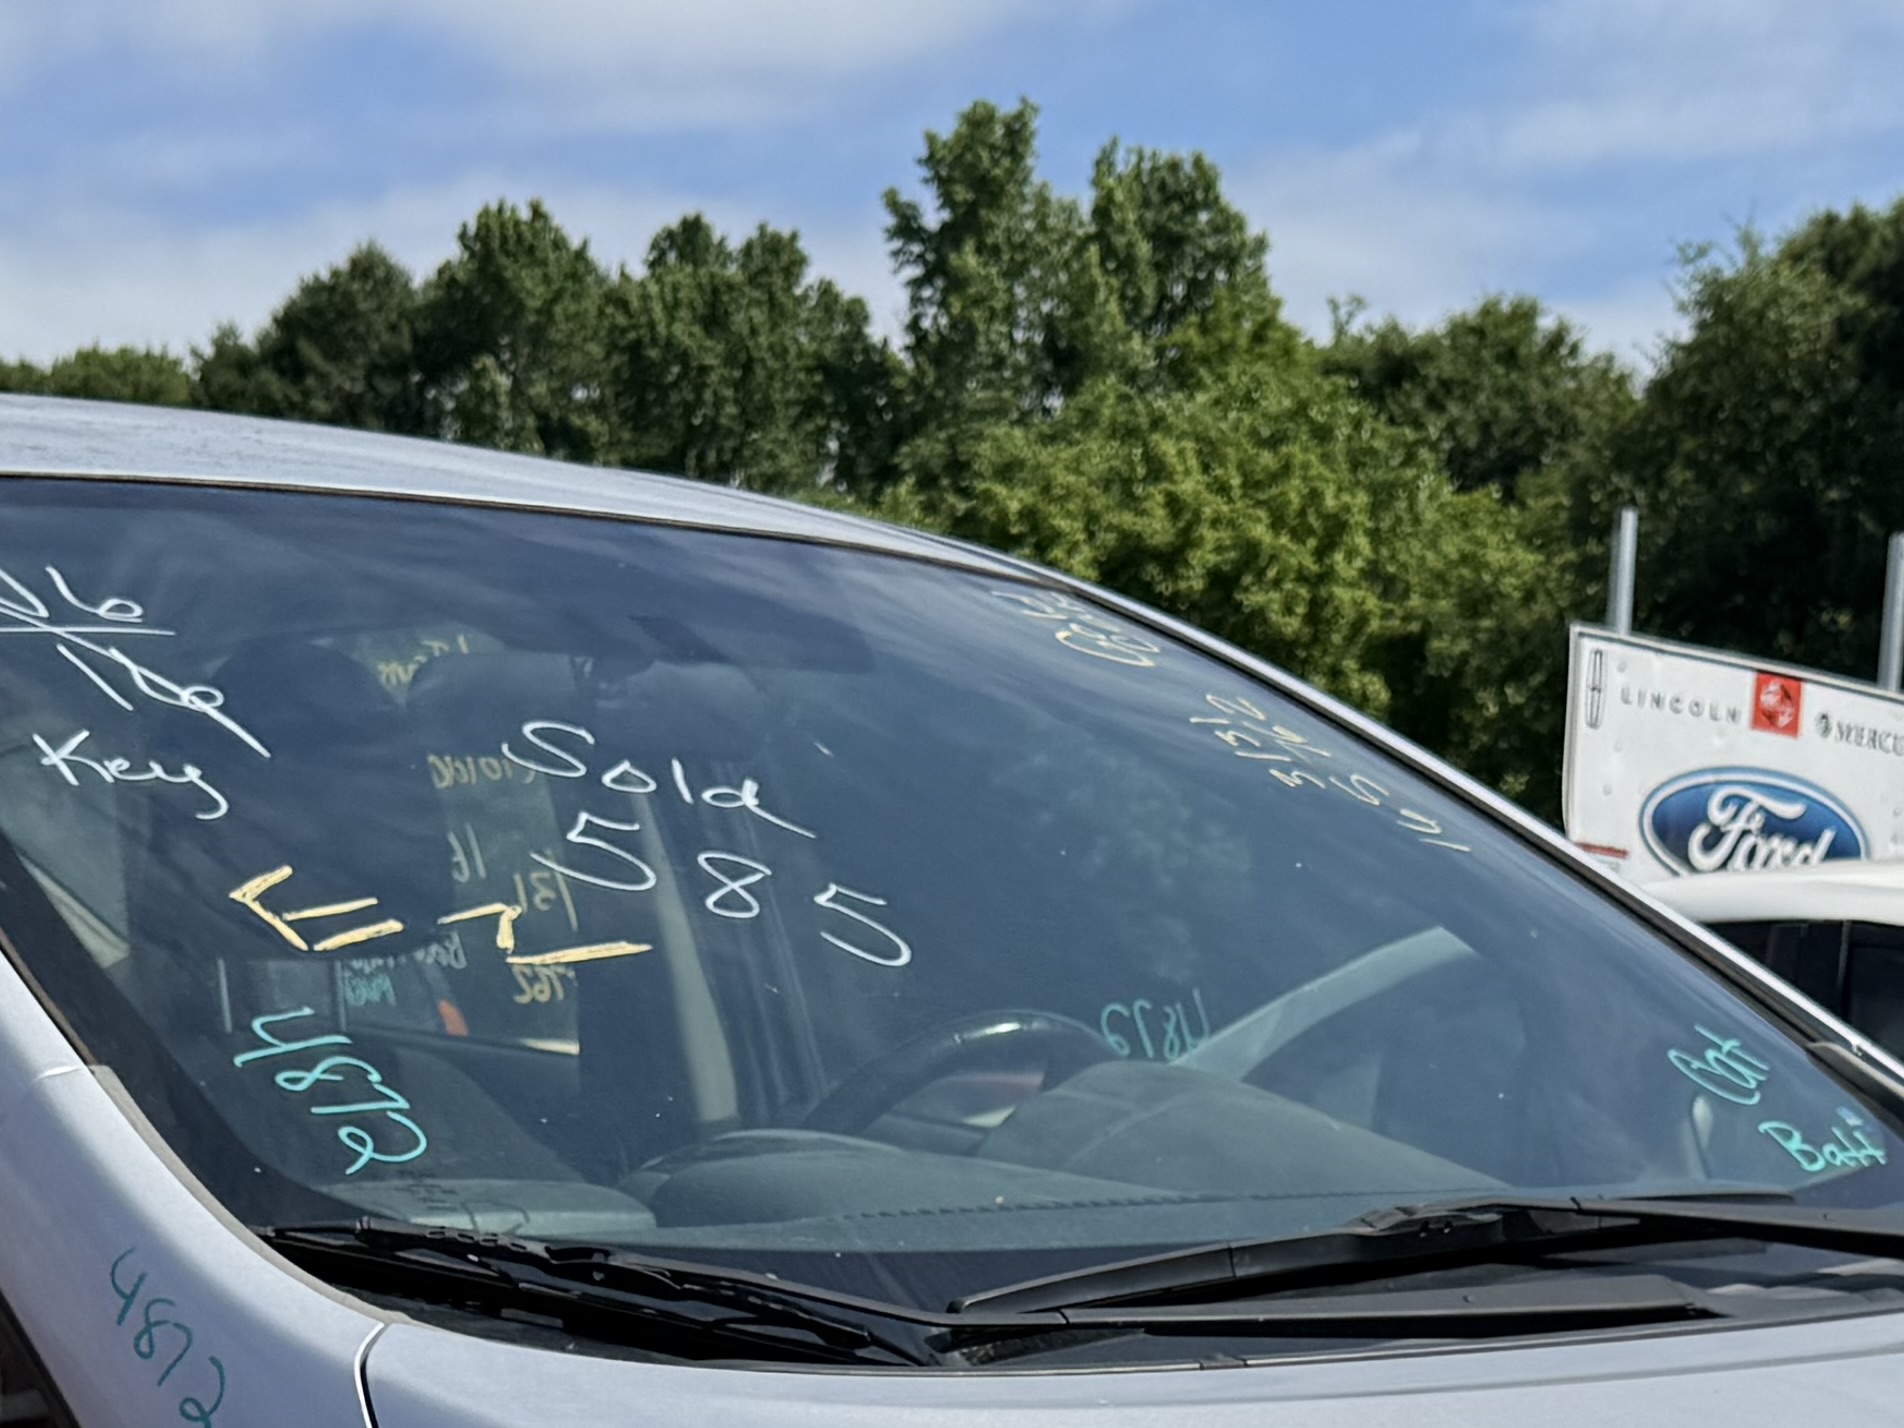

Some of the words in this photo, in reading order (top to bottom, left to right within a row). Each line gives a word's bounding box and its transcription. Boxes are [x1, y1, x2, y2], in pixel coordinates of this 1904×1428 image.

[1619, 686, 1743, 726] LINCOLN
[33, 730, 229, 820] Key
[1689, 786, 1837, 872] Ford
[530, 812, 912, 966] 585
[233, 1007, 428, 1176] 4872
[1668, 1026, 1771, 1105] Cat
